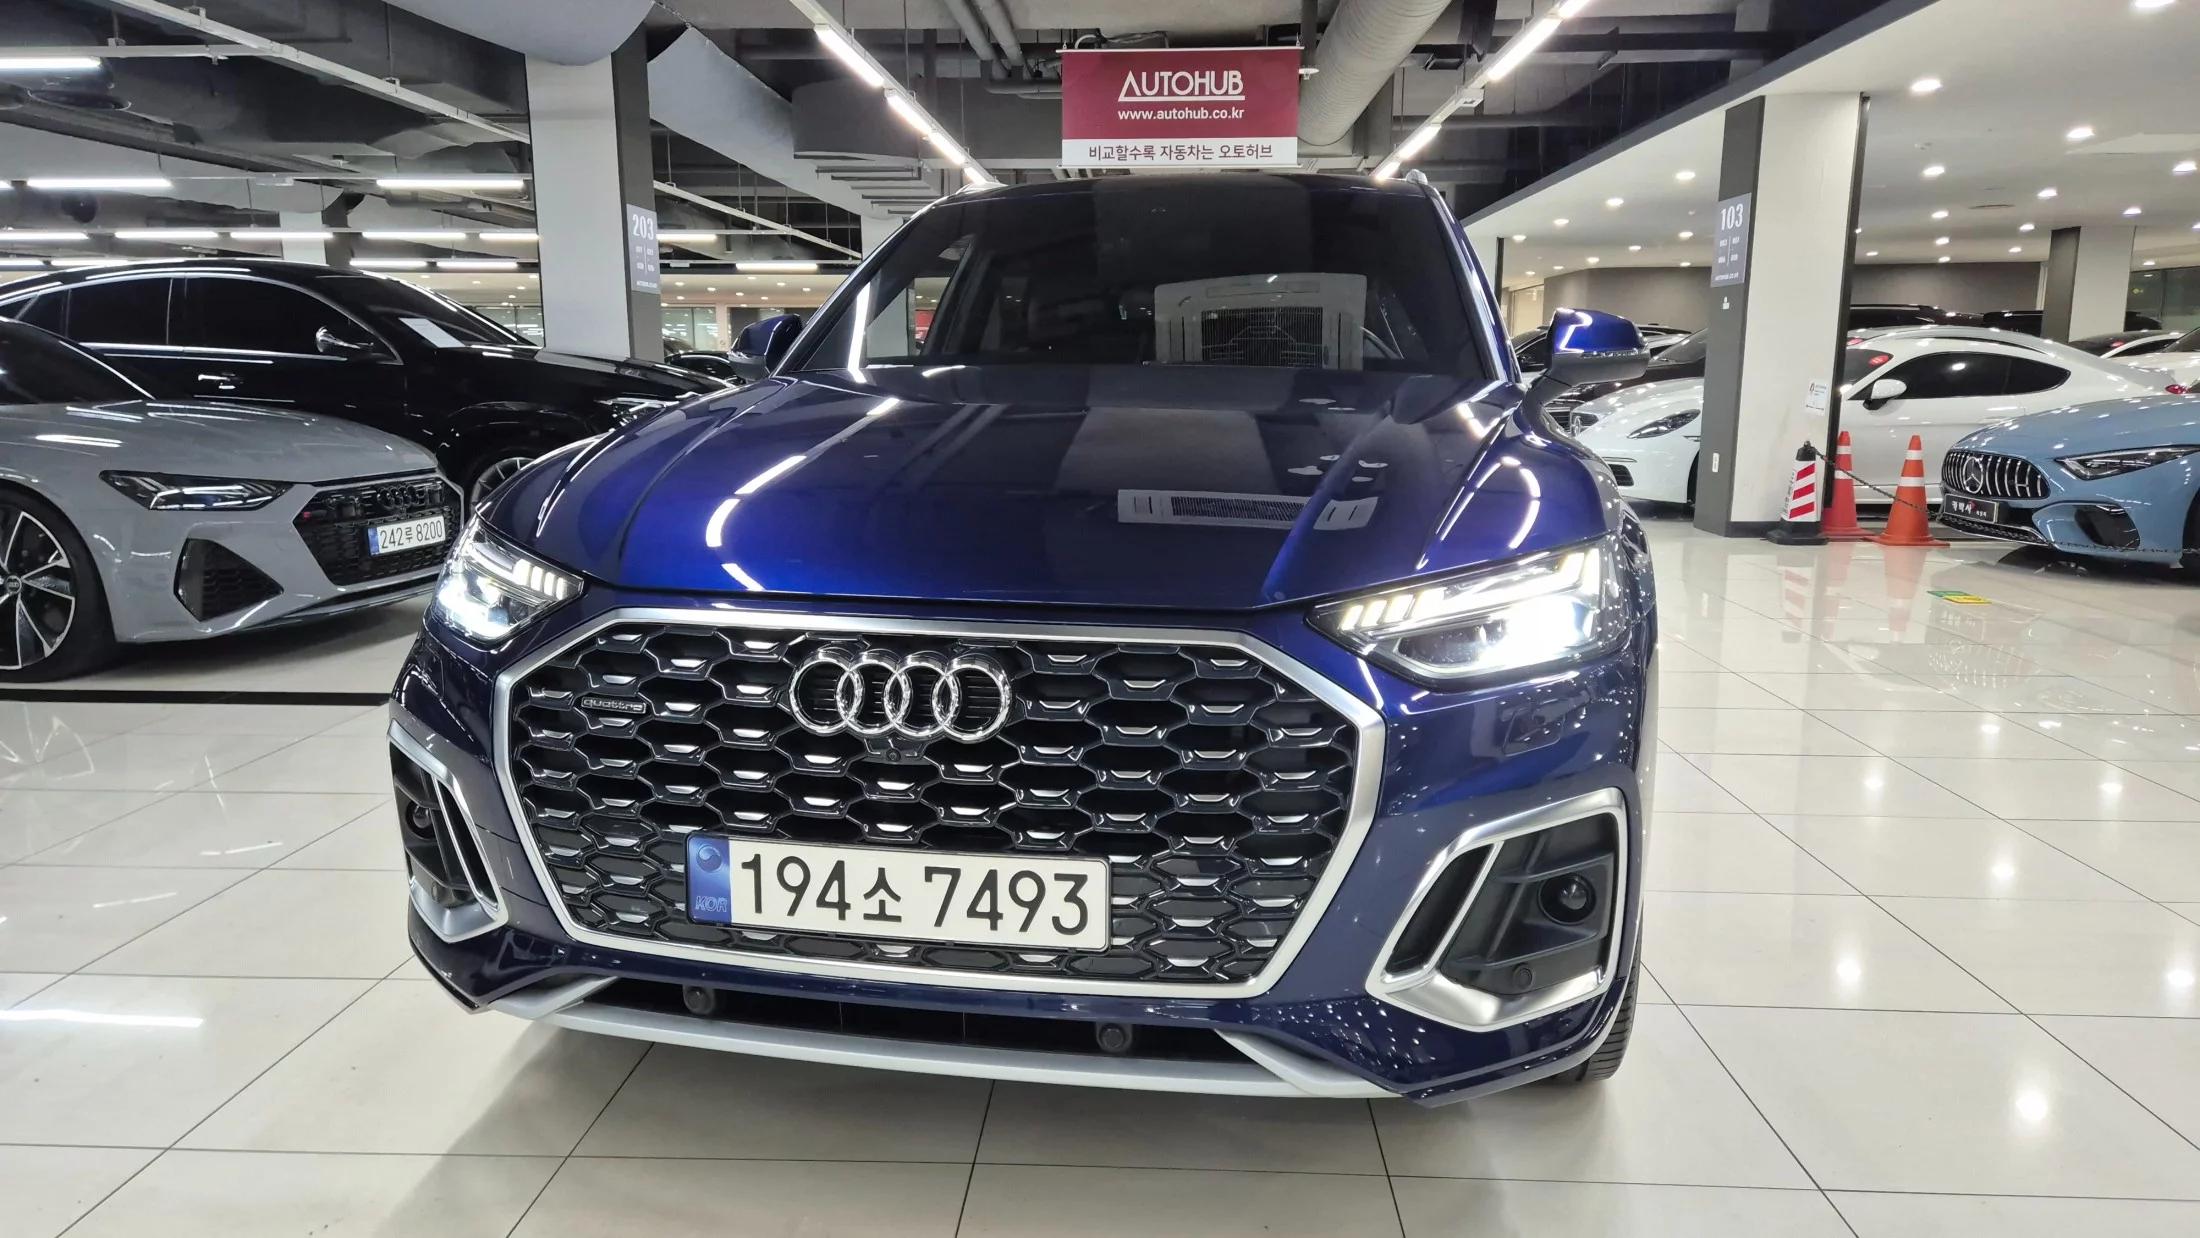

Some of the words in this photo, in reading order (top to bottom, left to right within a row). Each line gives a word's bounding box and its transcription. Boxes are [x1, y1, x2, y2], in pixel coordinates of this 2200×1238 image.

[1118, 70, 1245, 101] AUTOHUB
[1118, 107, 1244, 120] www.autohub.co.kr
[1088, 144, 1156, 161] 비교할수록
[1160, 144, 1215, 161] 자동차는
[1218, 143, 1273, 159] 오토허브
[632, 213, 654, 240] 203
[1721, 203, 1744, 231] 103
[380, 526, 412, 549] 242루
[416, 519, 443, 542] 8200
[583, 698, 644, 711] quattro
[695, 895, 729, 913] KOR
[741, 853, 903, 923] 194소
[924, 865, 1089, 936] 7493
